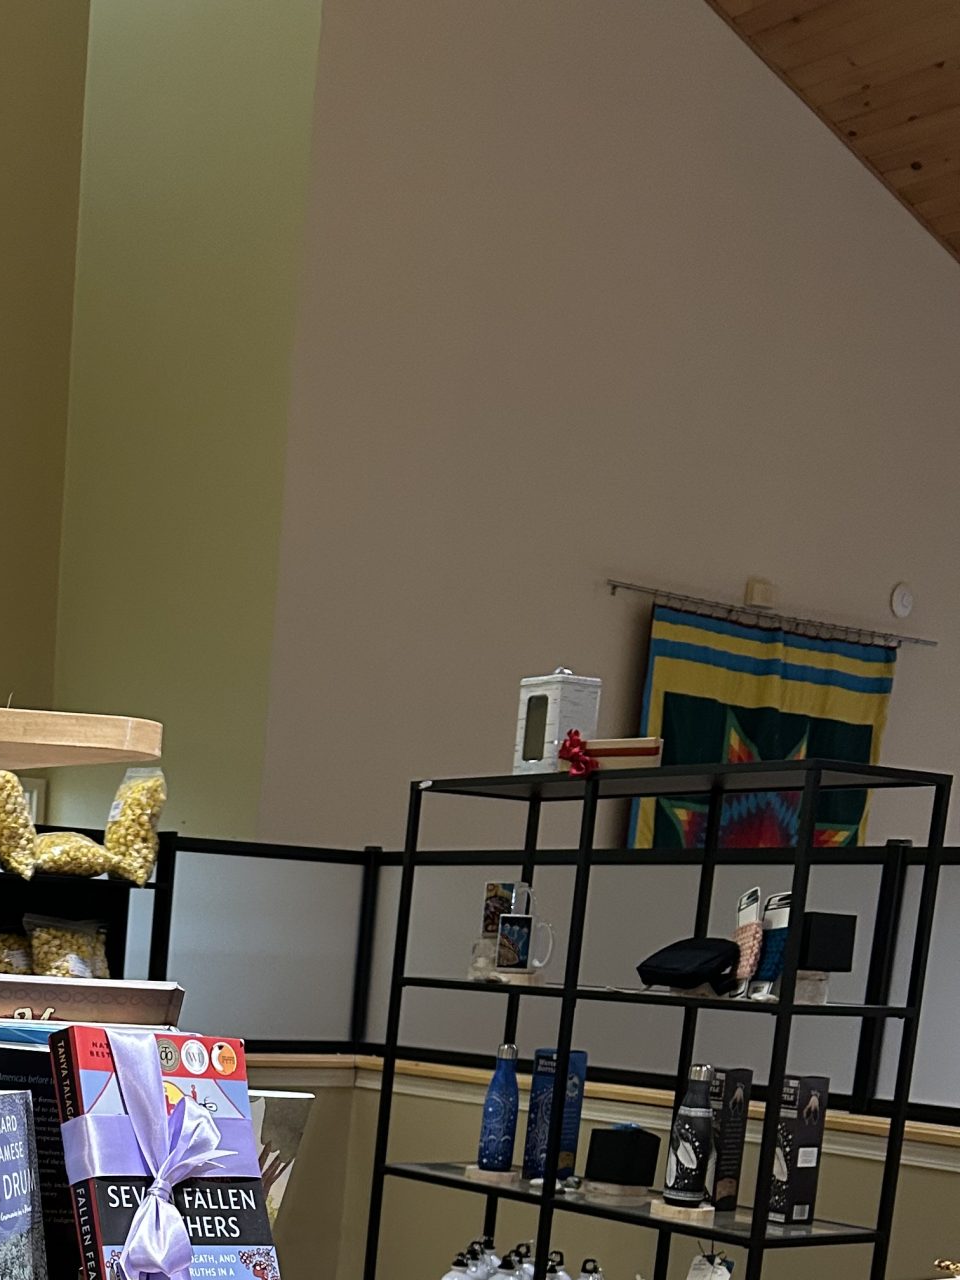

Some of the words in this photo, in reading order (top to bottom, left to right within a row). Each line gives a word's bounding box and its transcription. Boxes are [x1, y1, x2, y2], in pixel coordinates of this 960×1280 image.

[56, 1040, 70, 1071] TANYA
[3, 1168, 37, 1200] DRUM
[183, 1189, 257, 1211] FALLEN
[76, 1188, 92, 1247] FALLEN
[220, 1254, 237, 1263] AND
[190, 1267, 216, 1277] RUTHS
[218, 1268, 228, 1277] IN
[229, 1268, 235, 1277] A
